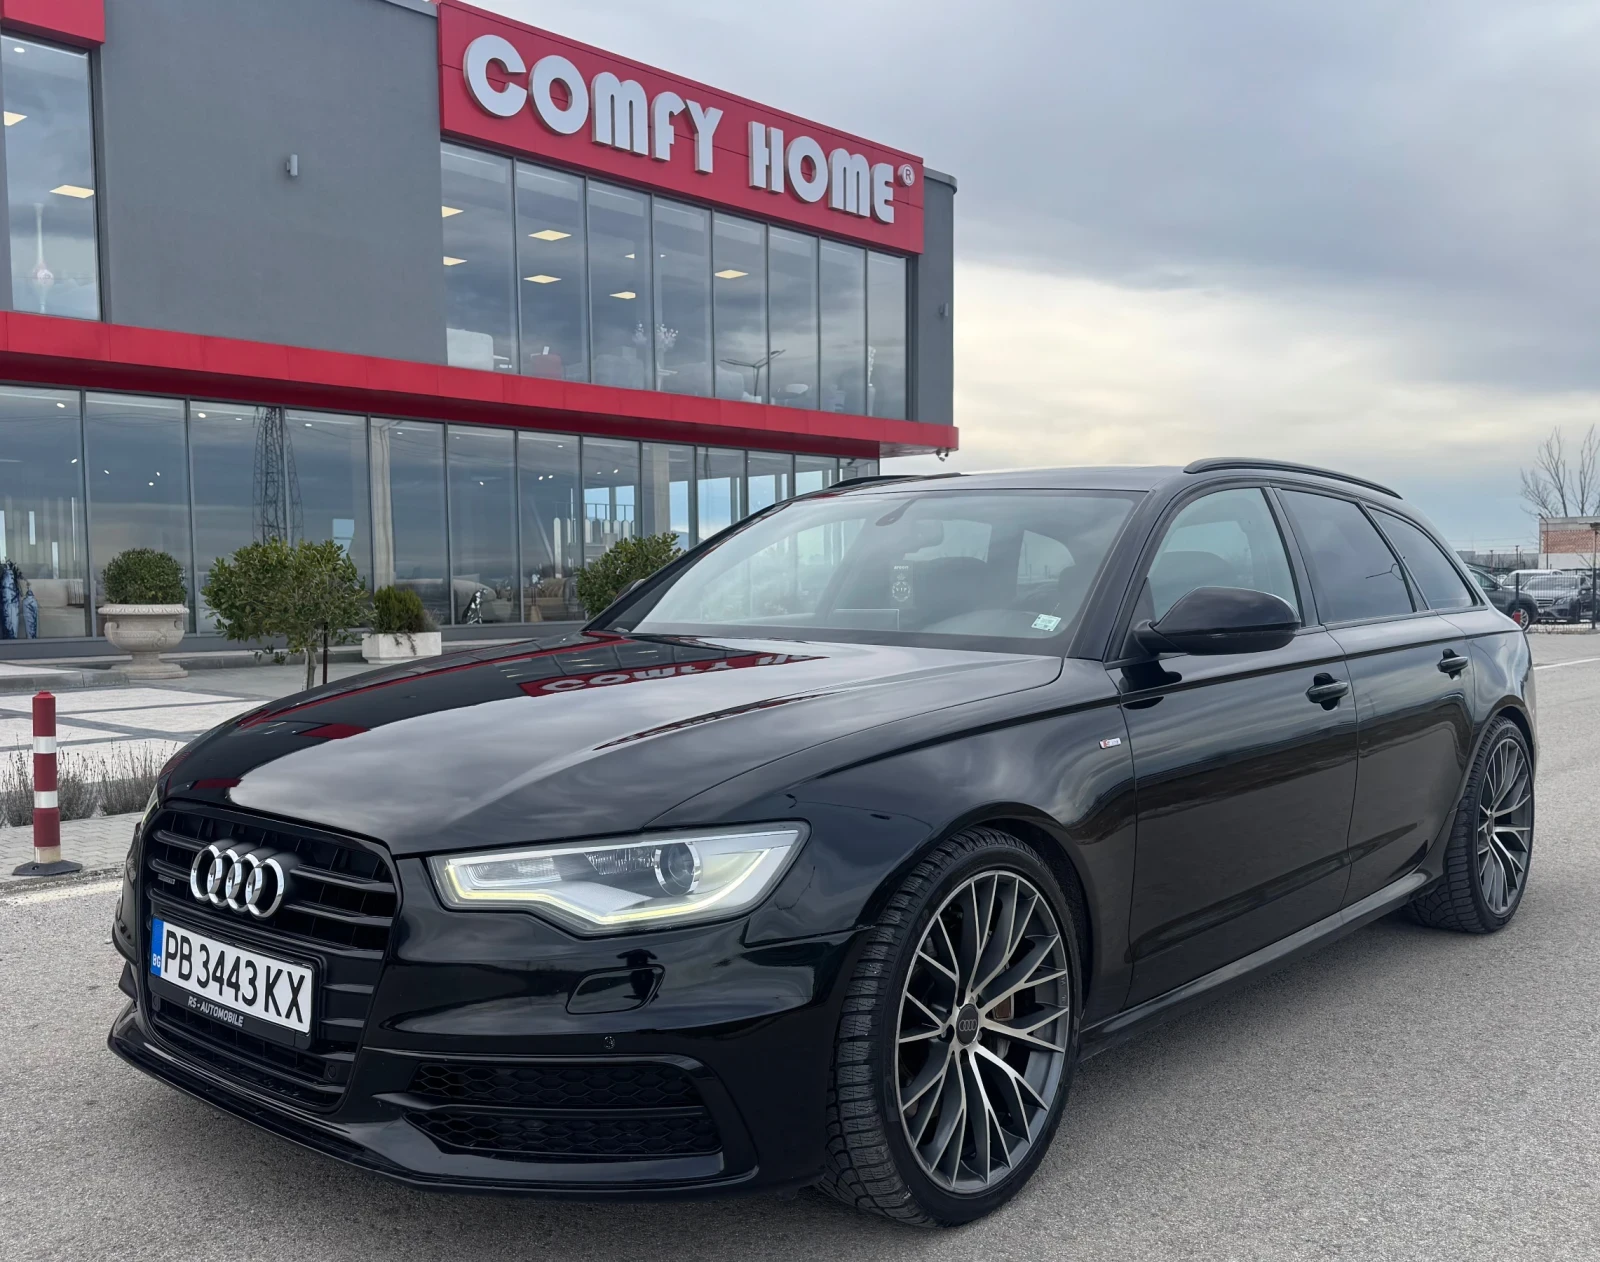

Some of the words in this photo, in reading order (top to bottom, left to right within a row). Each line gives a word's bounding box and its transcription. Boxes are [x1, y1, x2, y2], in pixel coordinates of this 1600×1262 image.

[463, 34, 723, 174] COMFY
[152, 954, 161, 967] BG
[197, 944, 258, 1007] 3443
